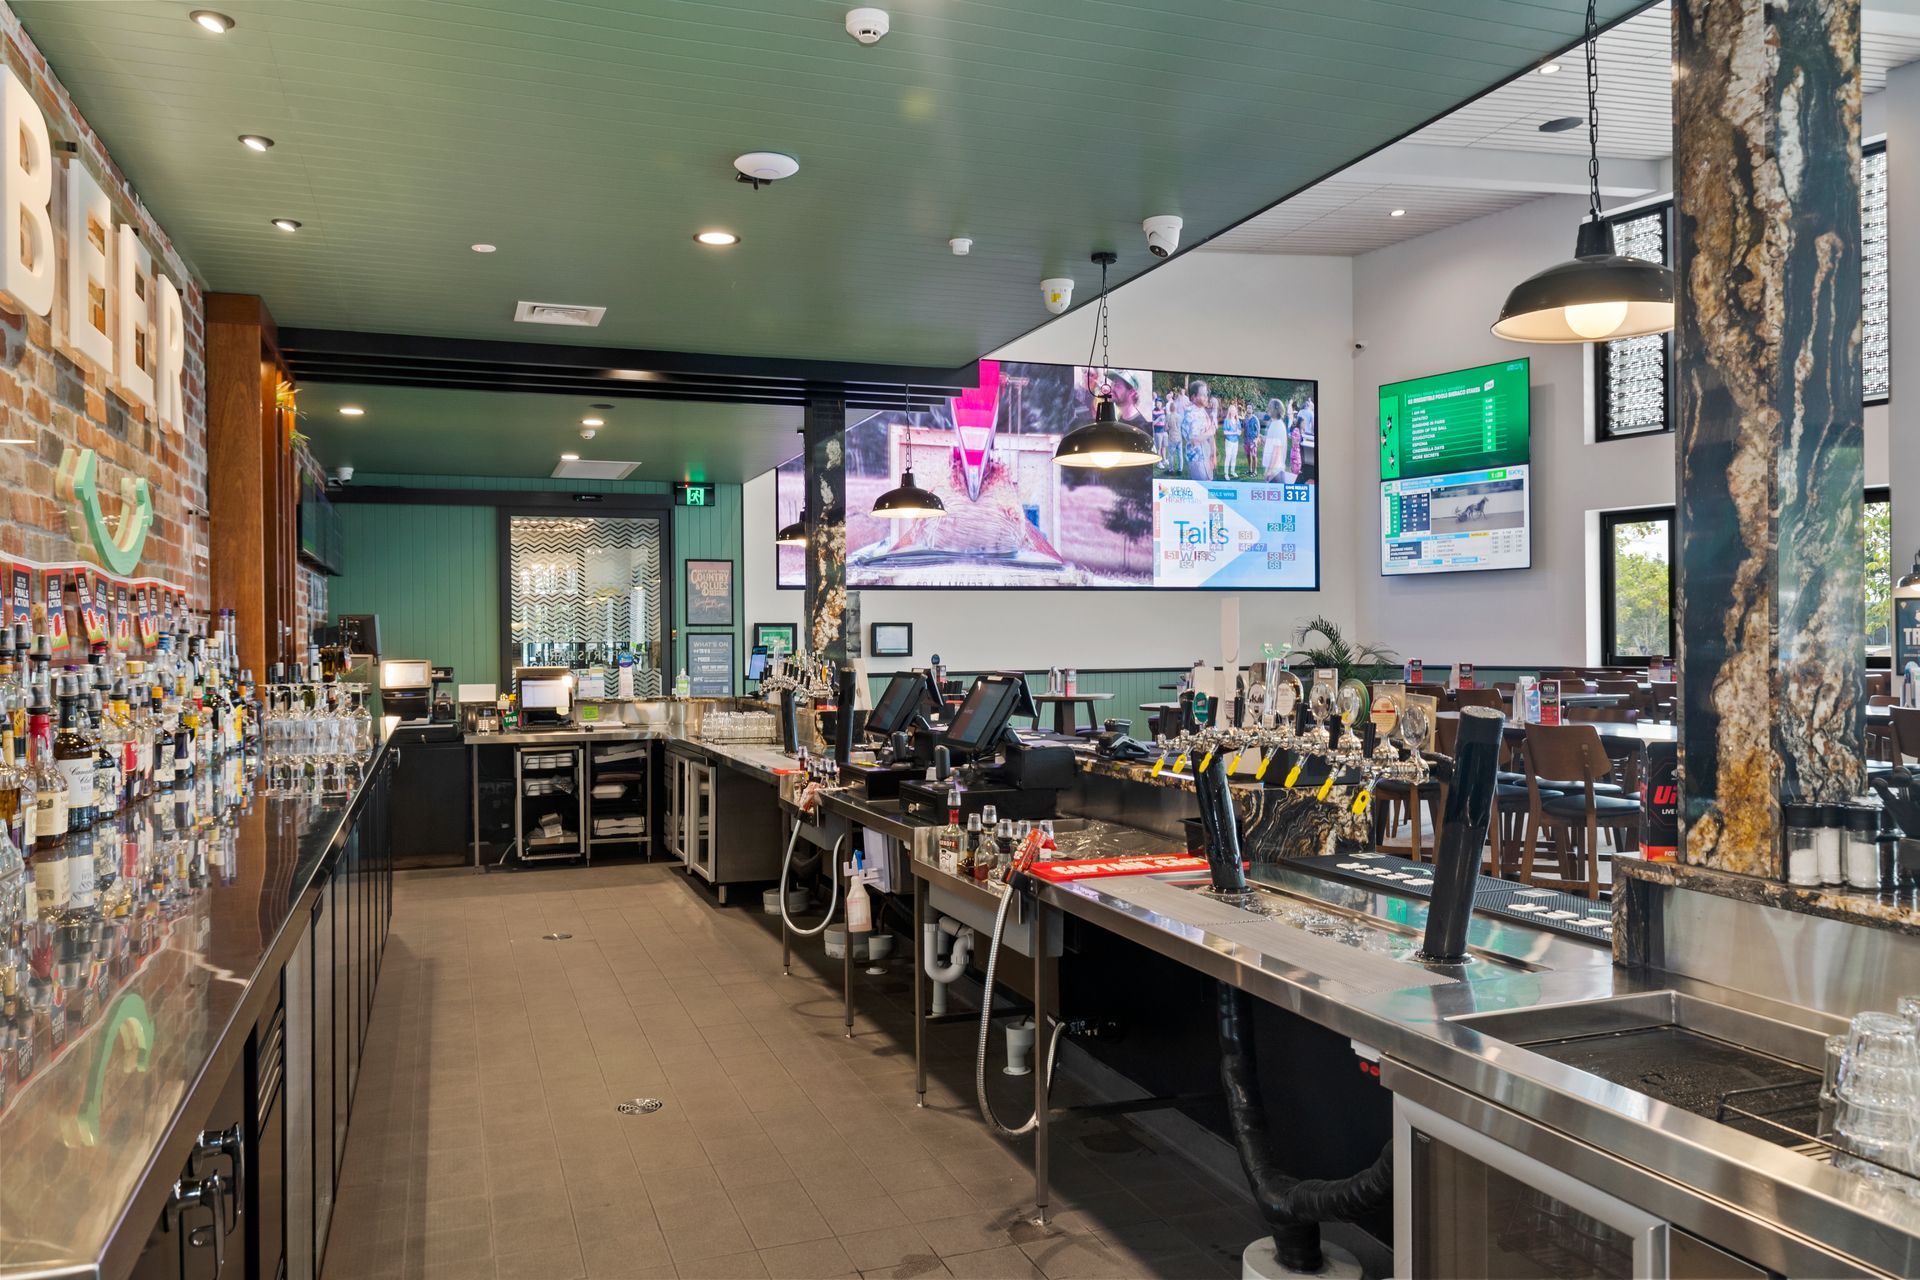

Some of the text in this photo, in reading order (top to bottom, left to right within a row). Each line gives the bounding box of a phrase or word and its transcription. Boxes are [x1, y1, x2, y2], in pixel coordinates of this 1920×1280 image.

[0, 63, 185, 435] BEER
[1286, 491, 1307, 501] 312
[1173, 520, 1230, 544] Tails
[691, 569, 729, 584] COUNTRY
[718, 641, 729, 649] ON
[504, 716, 518, 724] TAB
